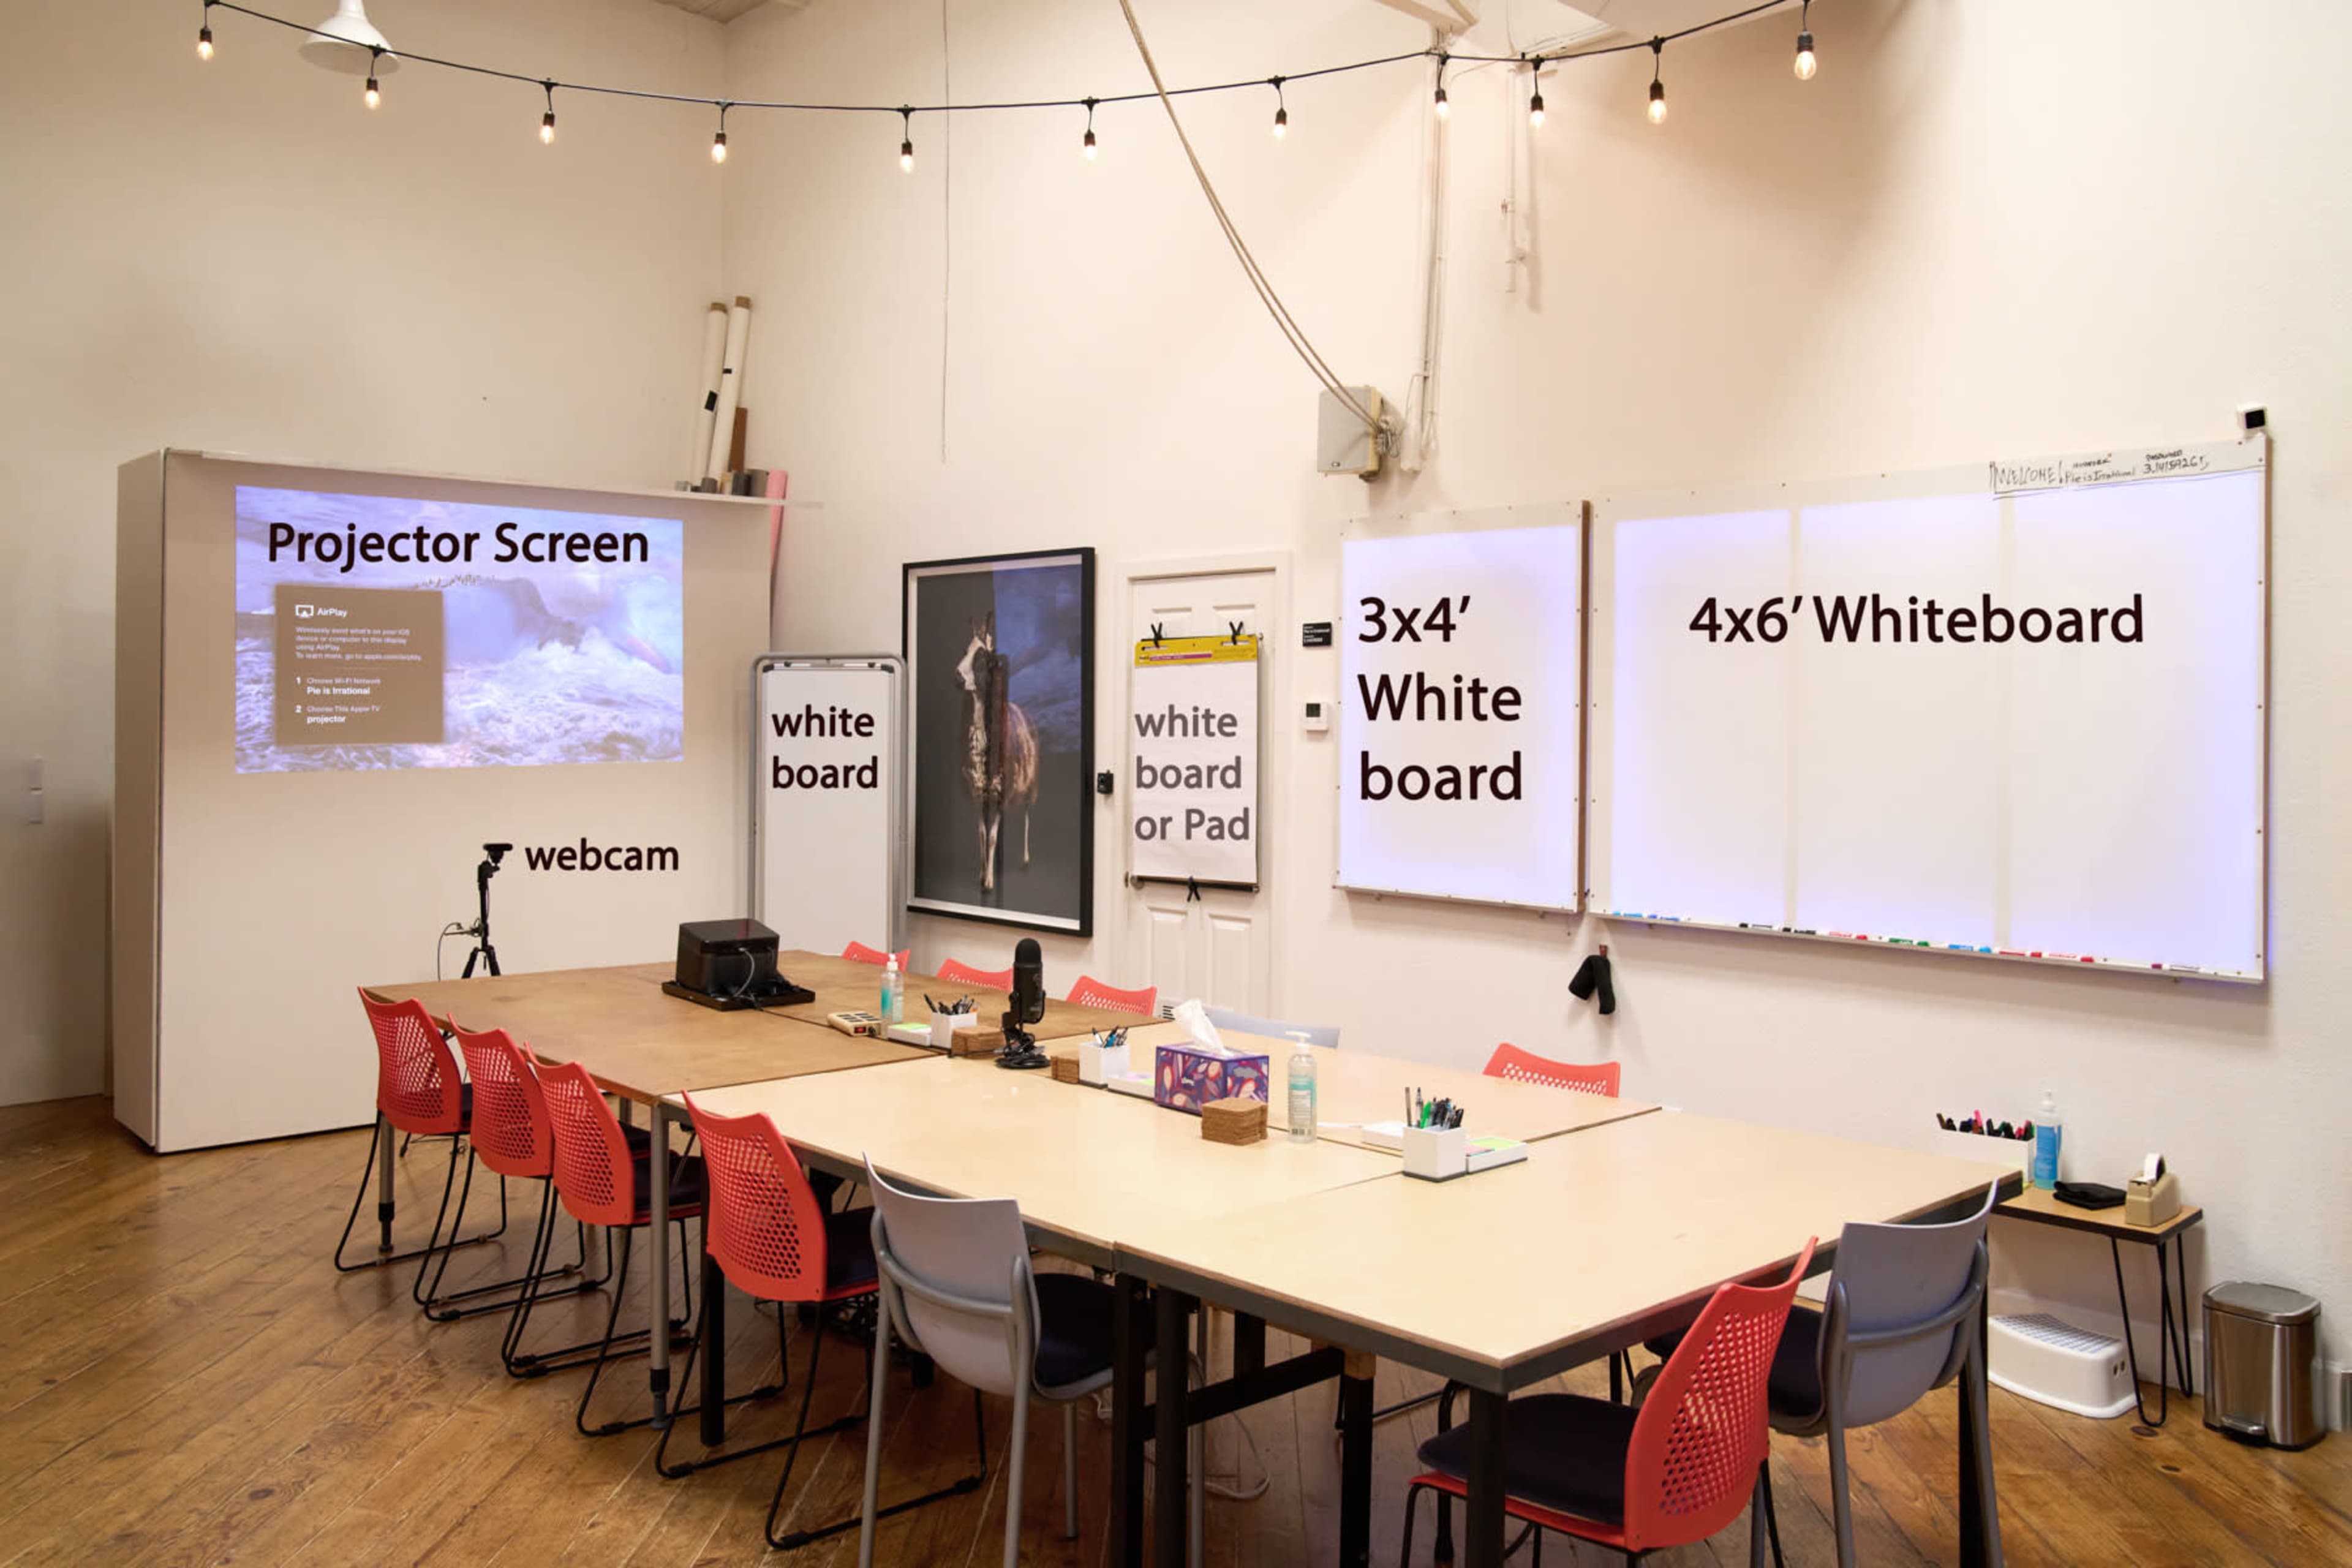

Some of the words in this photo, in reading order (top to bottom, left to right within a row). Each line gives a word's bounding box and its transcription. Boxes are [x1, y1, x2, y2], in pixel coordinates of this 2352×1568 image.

[317, 607, 347, 618] AirPlay
[296, 676, 301, 685] 1
[307, 686, 321, 695] Pie
[323, 686, 330, 695] is
[295, 704, 301, 714] 2
[306, 715, 346, 725] projector
